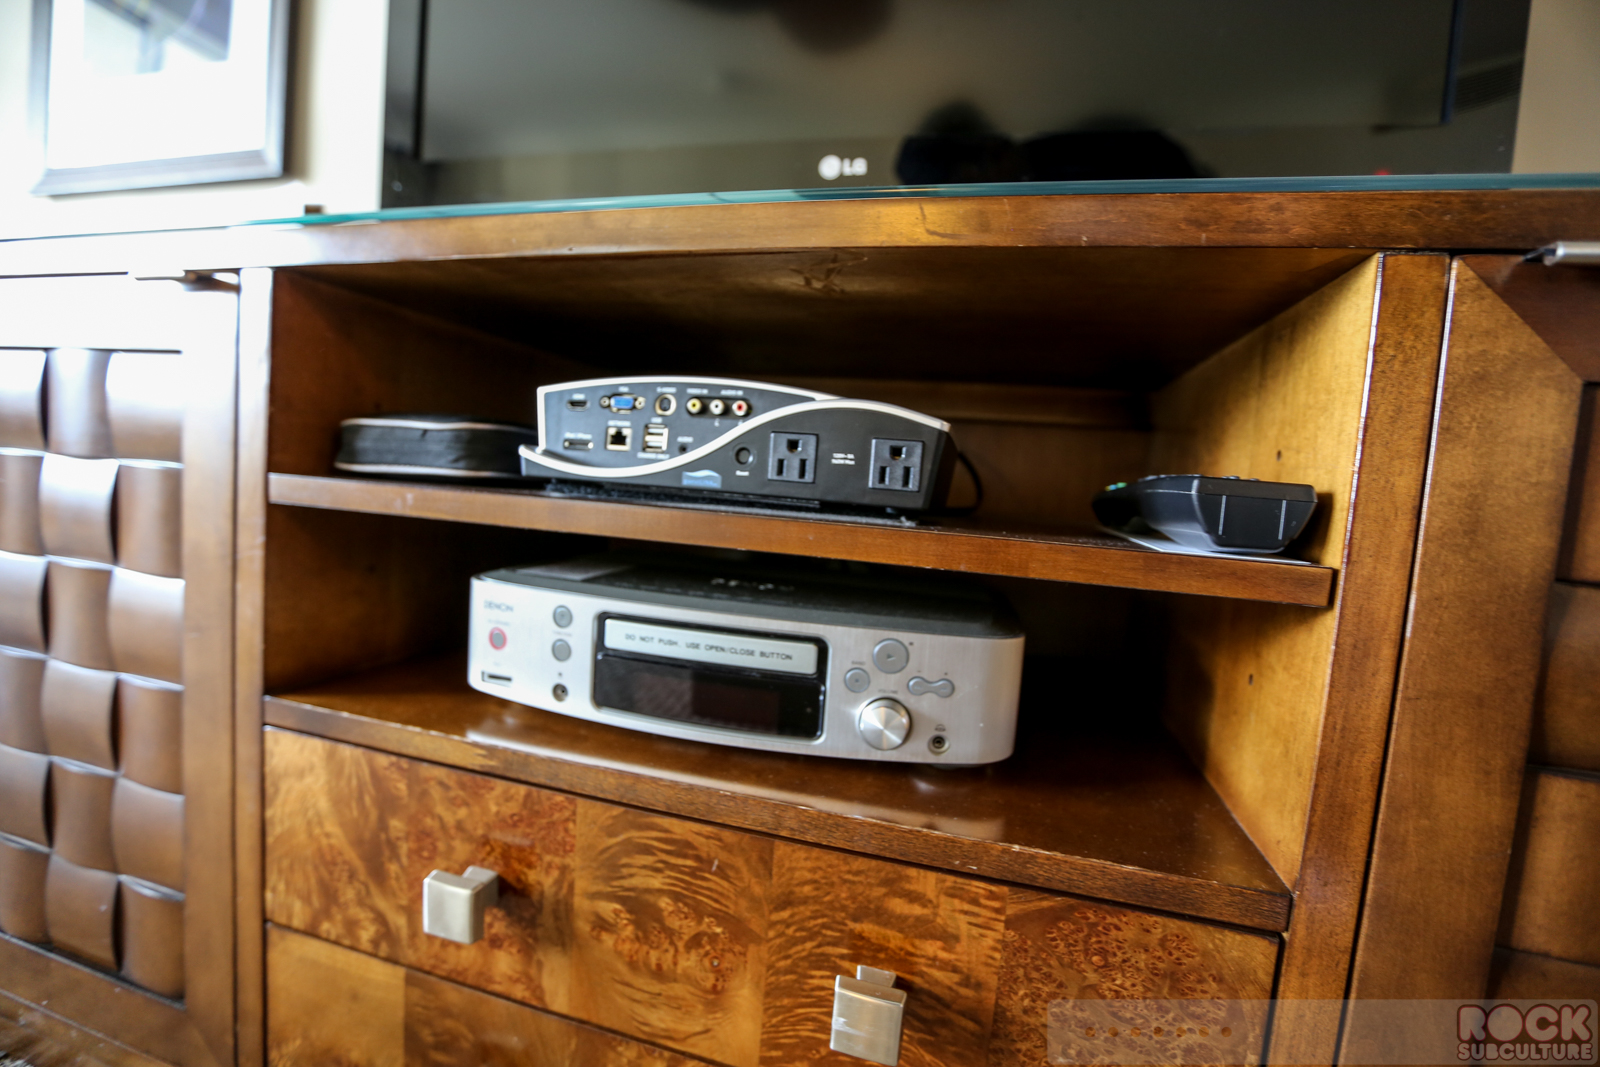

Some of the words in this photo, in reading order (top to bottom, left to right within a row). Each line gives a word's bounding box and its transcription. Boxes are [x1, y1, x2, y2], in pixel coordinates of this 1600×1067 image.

[625, 633, 635, 641] DO
[639, 635, 654, 643] NOT
[685, 642, 701, 650] USE
[704, 644, 756, 657] OPEN/CLOSE
[759, 650, 793, 661] BUTTON
